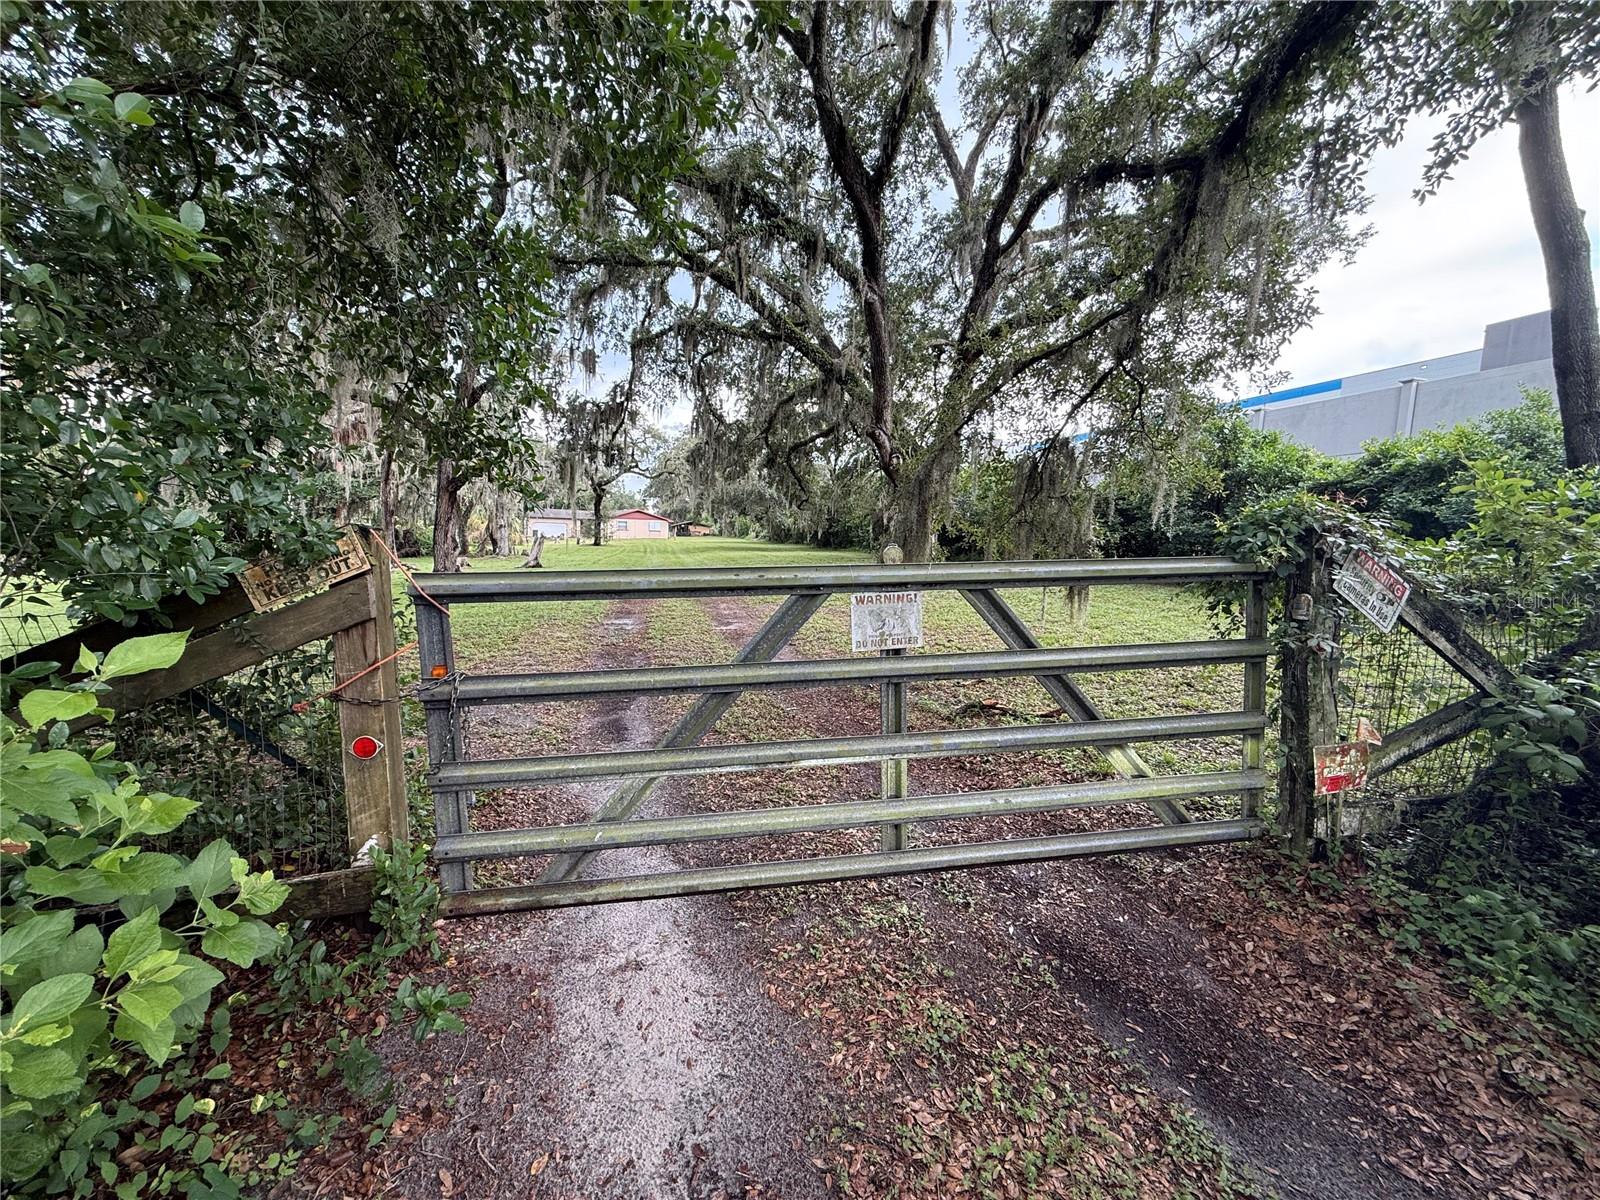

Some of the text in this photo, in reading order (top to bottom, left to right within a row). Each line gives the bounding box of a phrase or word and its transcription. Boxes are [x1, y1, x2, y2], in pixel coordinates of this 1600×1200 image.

[263, 573, 311, 600] KEEP
[318, 556, 352, 579] OUT
[1357, 553, 1402, 597] WARNING
[855, 593, 917, 605] WARNING!
[855, 641, 868, 649] DO
[870, 638, 889, 648] NOT
